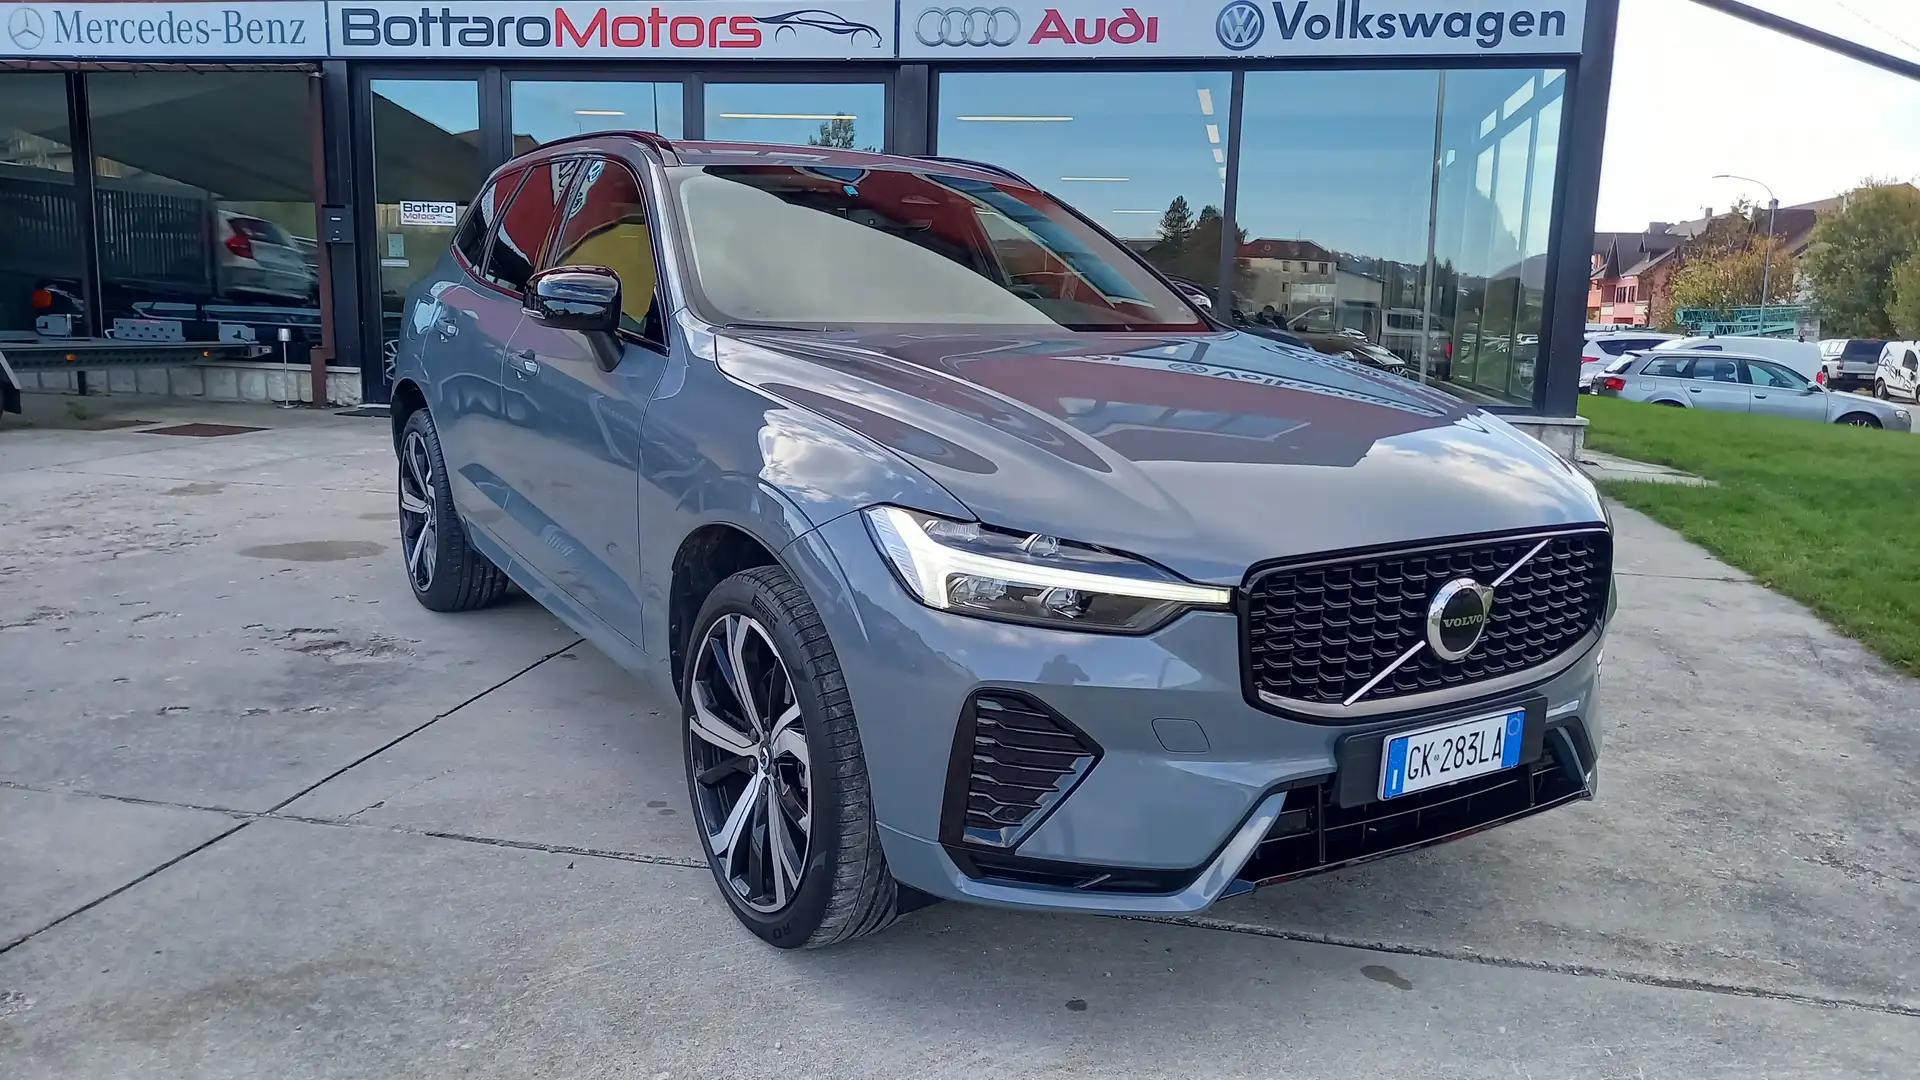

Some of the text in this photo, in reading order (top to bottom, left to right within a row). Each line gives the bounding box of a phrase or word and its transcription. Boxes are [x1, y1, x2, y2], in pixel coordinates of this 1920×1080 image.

[53, 10, 306, 44] Mercedes-Benz
[1028, 8, 1158, 45] Audi
[1272, 0, 1566, 48] Volkswagen
[403, 203, 453, 213] Bottaro
[1443, 614, 1483, 628] VOLVO
[1407, 727, 1502, 780] GK 283LA
